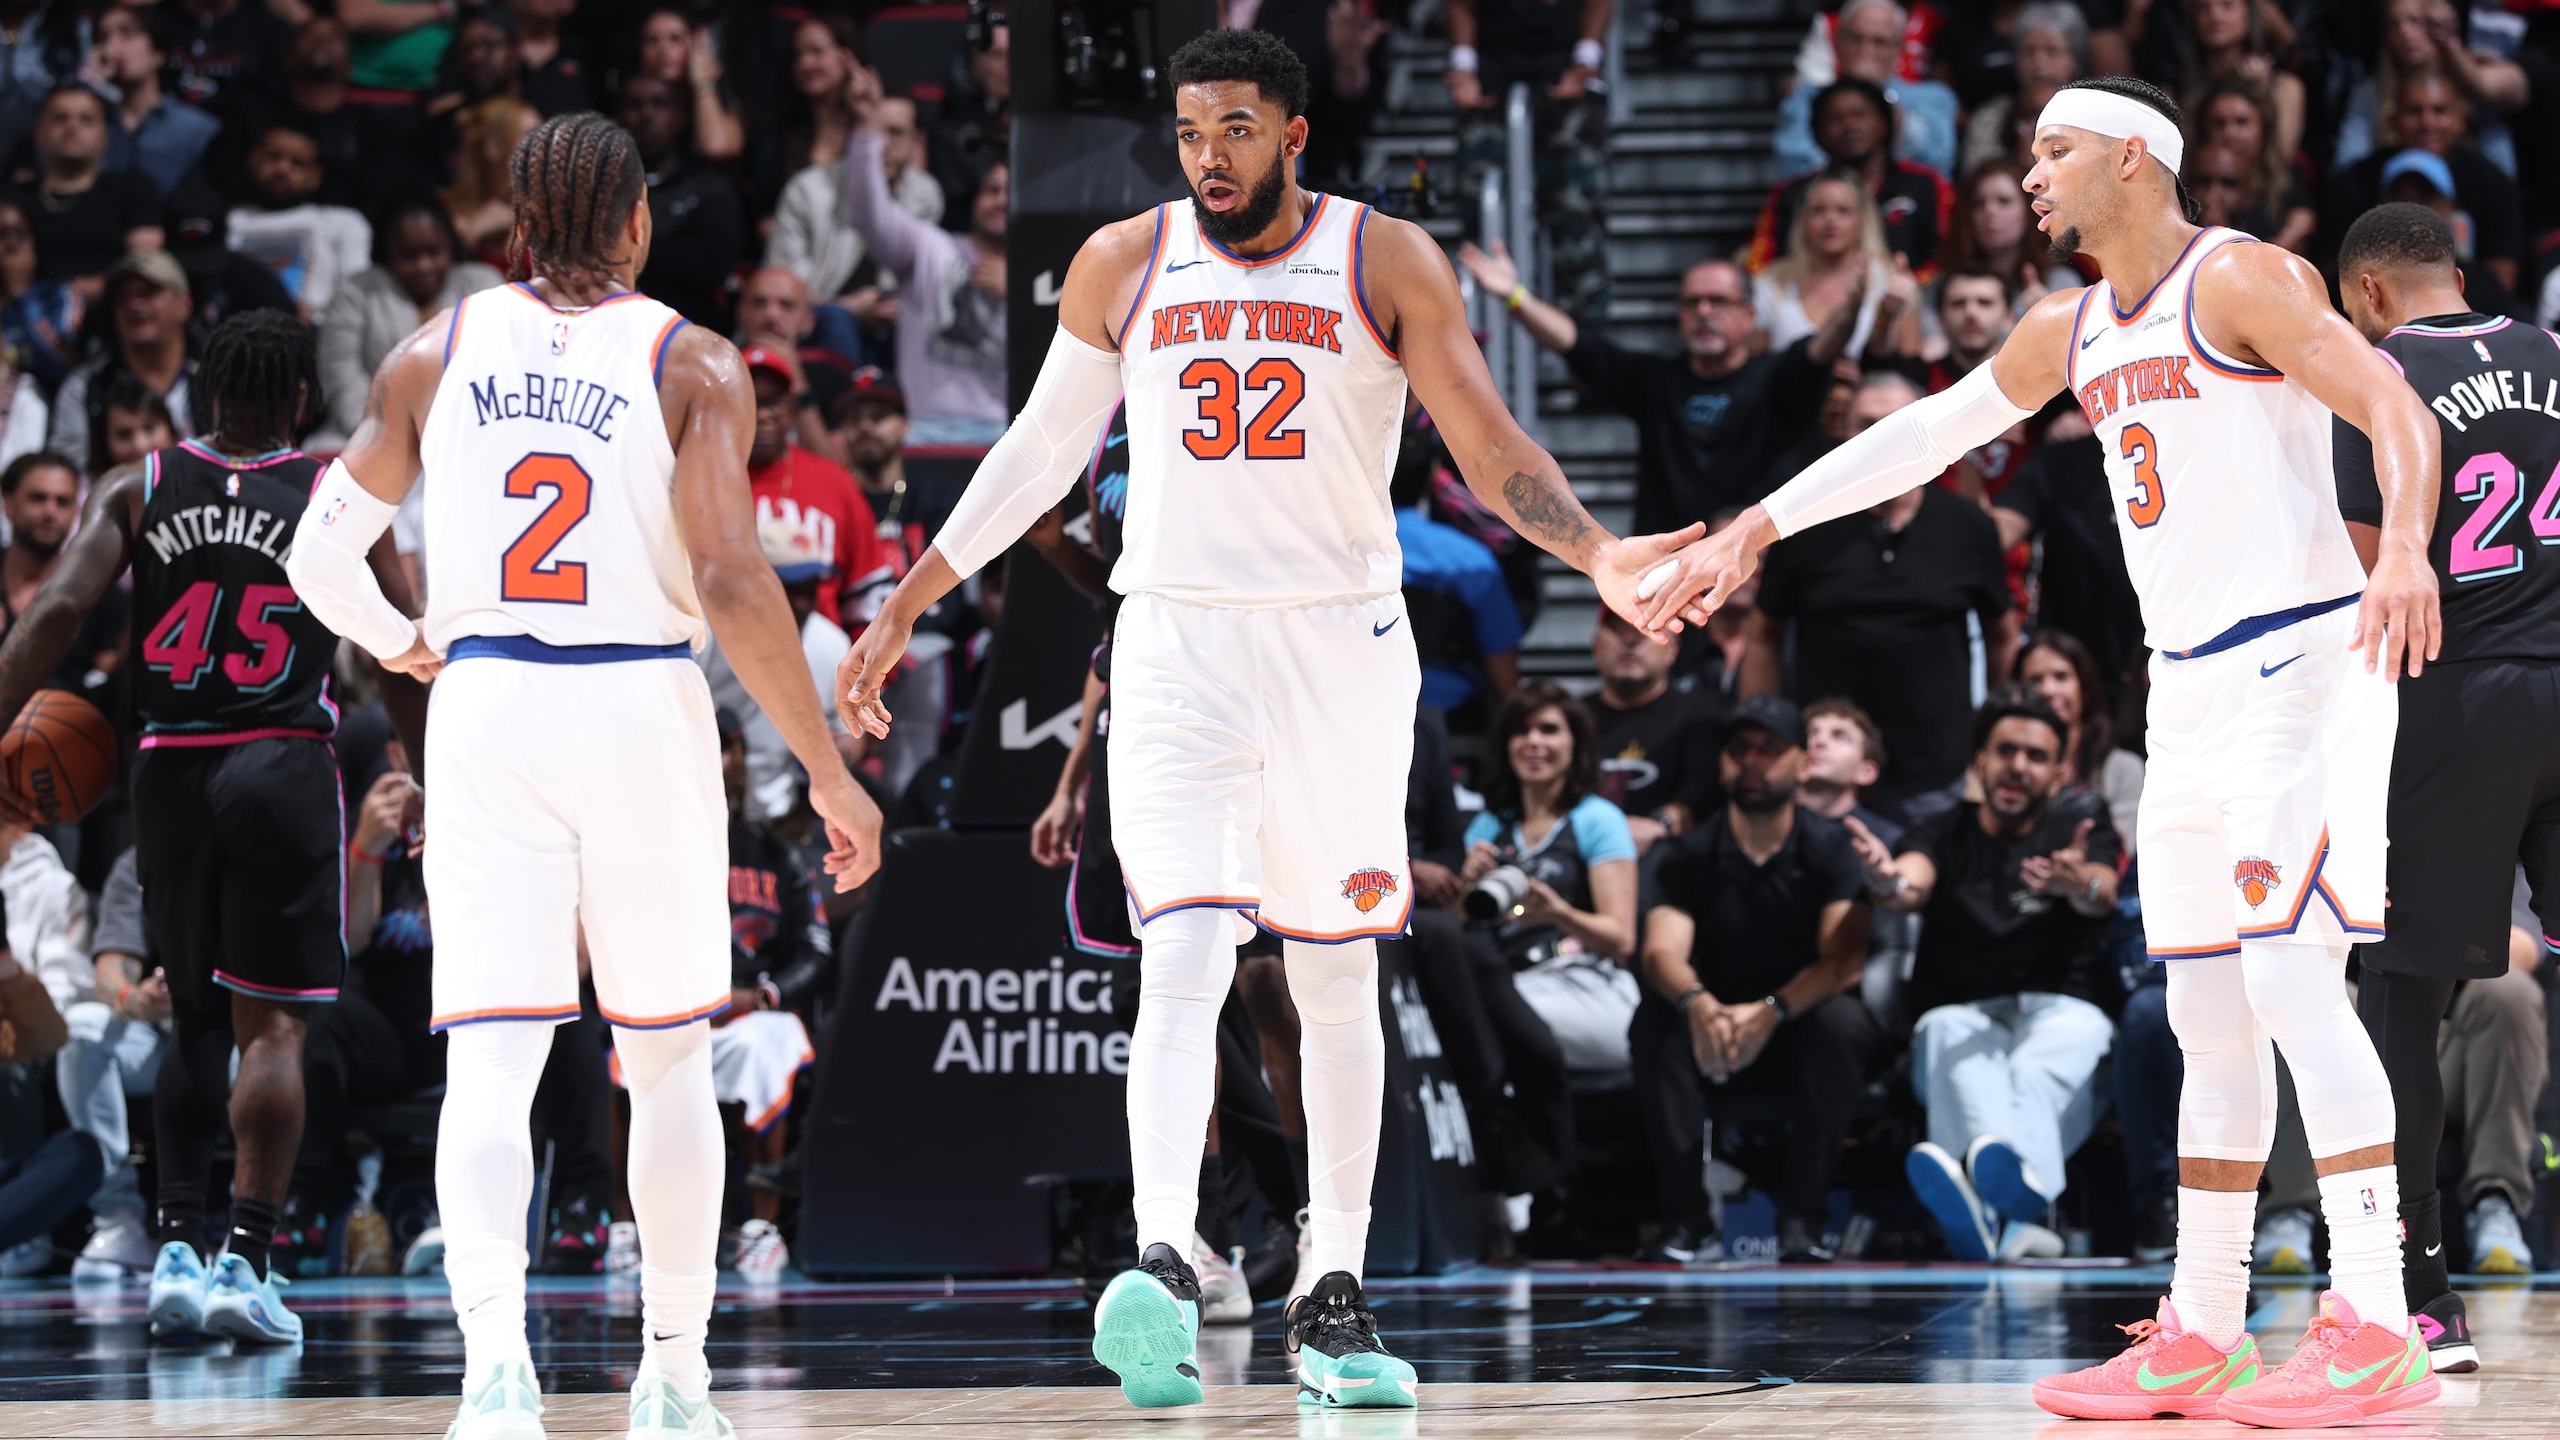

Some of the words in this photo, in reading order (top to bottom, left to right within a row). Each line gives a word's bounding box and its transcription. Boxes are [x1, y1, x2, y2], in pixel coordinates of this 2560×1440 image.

[1288, 267, 1308, 275] abu
[1310, 267, 1339, 277] dhabi
[1150, 300, 1236, 352] NEW
[1240, 300, 1343, 355] YORK
[469, 372, 630, 443] McBRIDE
[1179, 357, 1306, 460] 32
[2120, 356, 2200, 408] YORK
[2430, 369, 2560, 433] POWELL
[2120, 421, 2166, 530] 3
[500, 451, 593, 606] 2
[142, 581, 303, 694] 45
[1341, 870, 1397, 895] KNICKS
[2234, 859, 2281, 883] KNICKS
